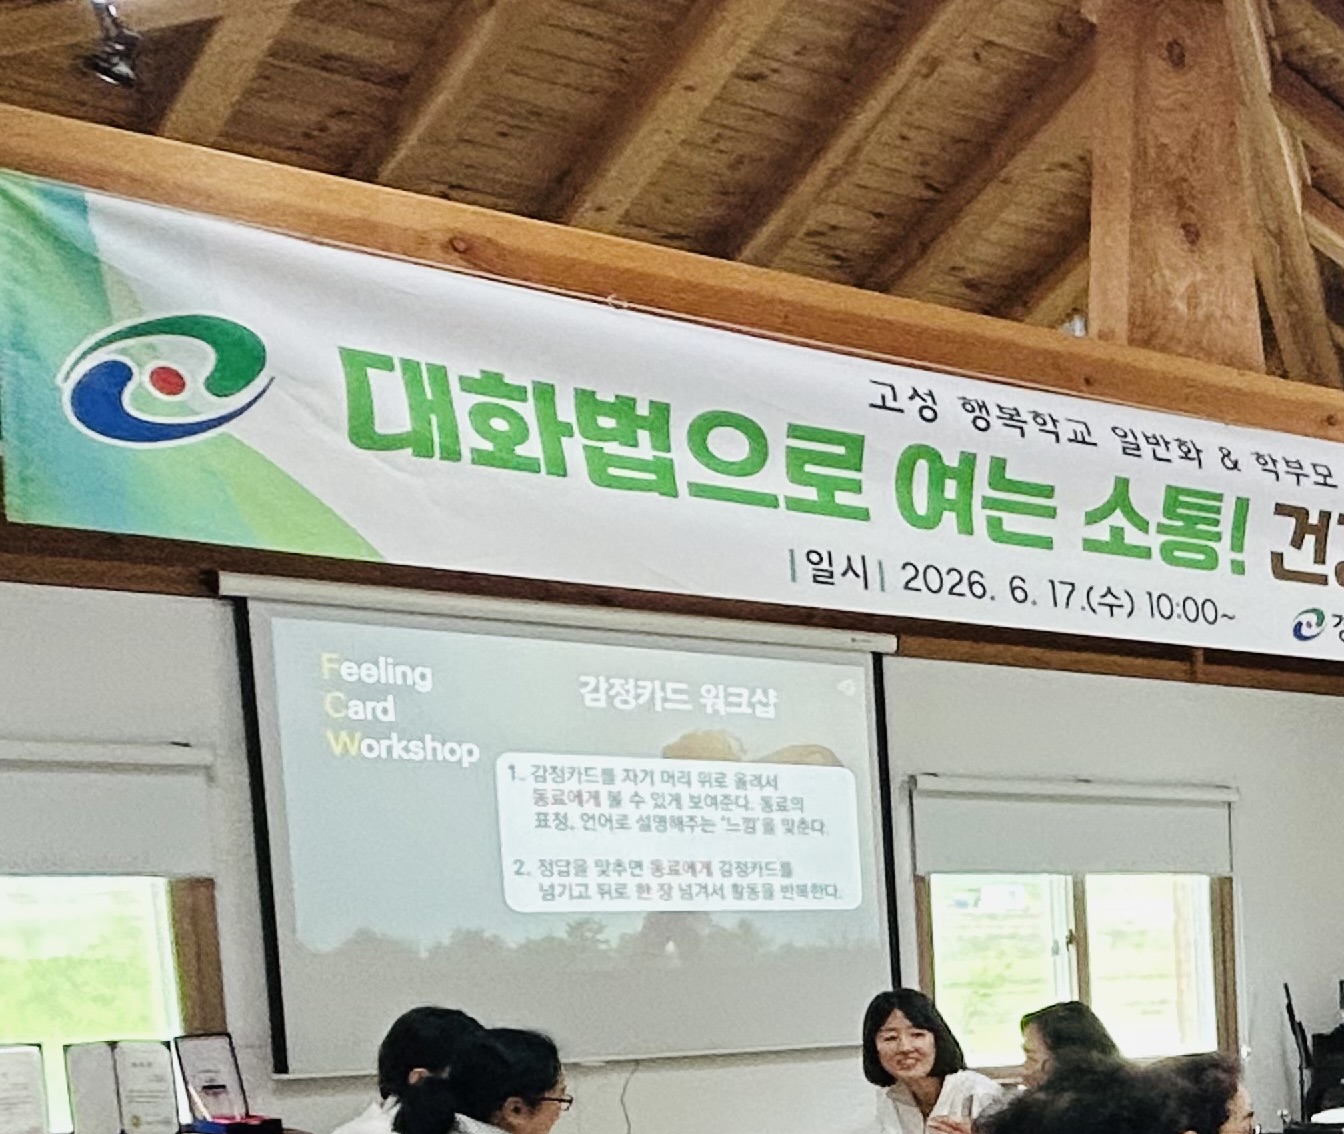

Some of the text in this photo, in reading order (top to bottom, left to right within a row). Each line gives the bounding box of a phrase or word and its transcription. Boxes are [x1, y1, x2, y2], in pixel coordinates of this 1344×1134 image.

[868, 378, 939, 424] 고성
[957, 395, 1098, 448] 행복학교
[1111, 425, 1204, 470] 일반화
[1219, 446, 1242, 472] &
[1250, 451, 1339, 490] 학부모
[337, 345, 872, 522] 대화법으로
[894, 442, 1058, 551] 여는
[1081, 475, 1251, 577] 소통!
[900, 561, 996, 602] 2026.
[1008, 574, 1038, 606] 6.
[1048, 579, 1136, 619] 17.(수)
[1146, 590, 1237, 626] 10:00~
[321, 652, 434, 693] Feeling
[324, 690, 396, 723] Card
[578, 675, 778, 719] 감정카드 워크샵
[326, 728, 481, 768] Workshop
[530, 764, 616, 785] 감정카드를
[621, 768, 656, 787] 자기
[660, 770, 692, 788] 머리
[697, 771, 728, 788] 위로
[532, 788, 602, 808] 동료에게
[628, 791, 646, 809] 수
[650, 791, 682, 810] 있게
[580, 812, 632, 832] 언어로
[636, 813, 716, 834] 설명해주는
[538, 858, 589, 878] 정답을
